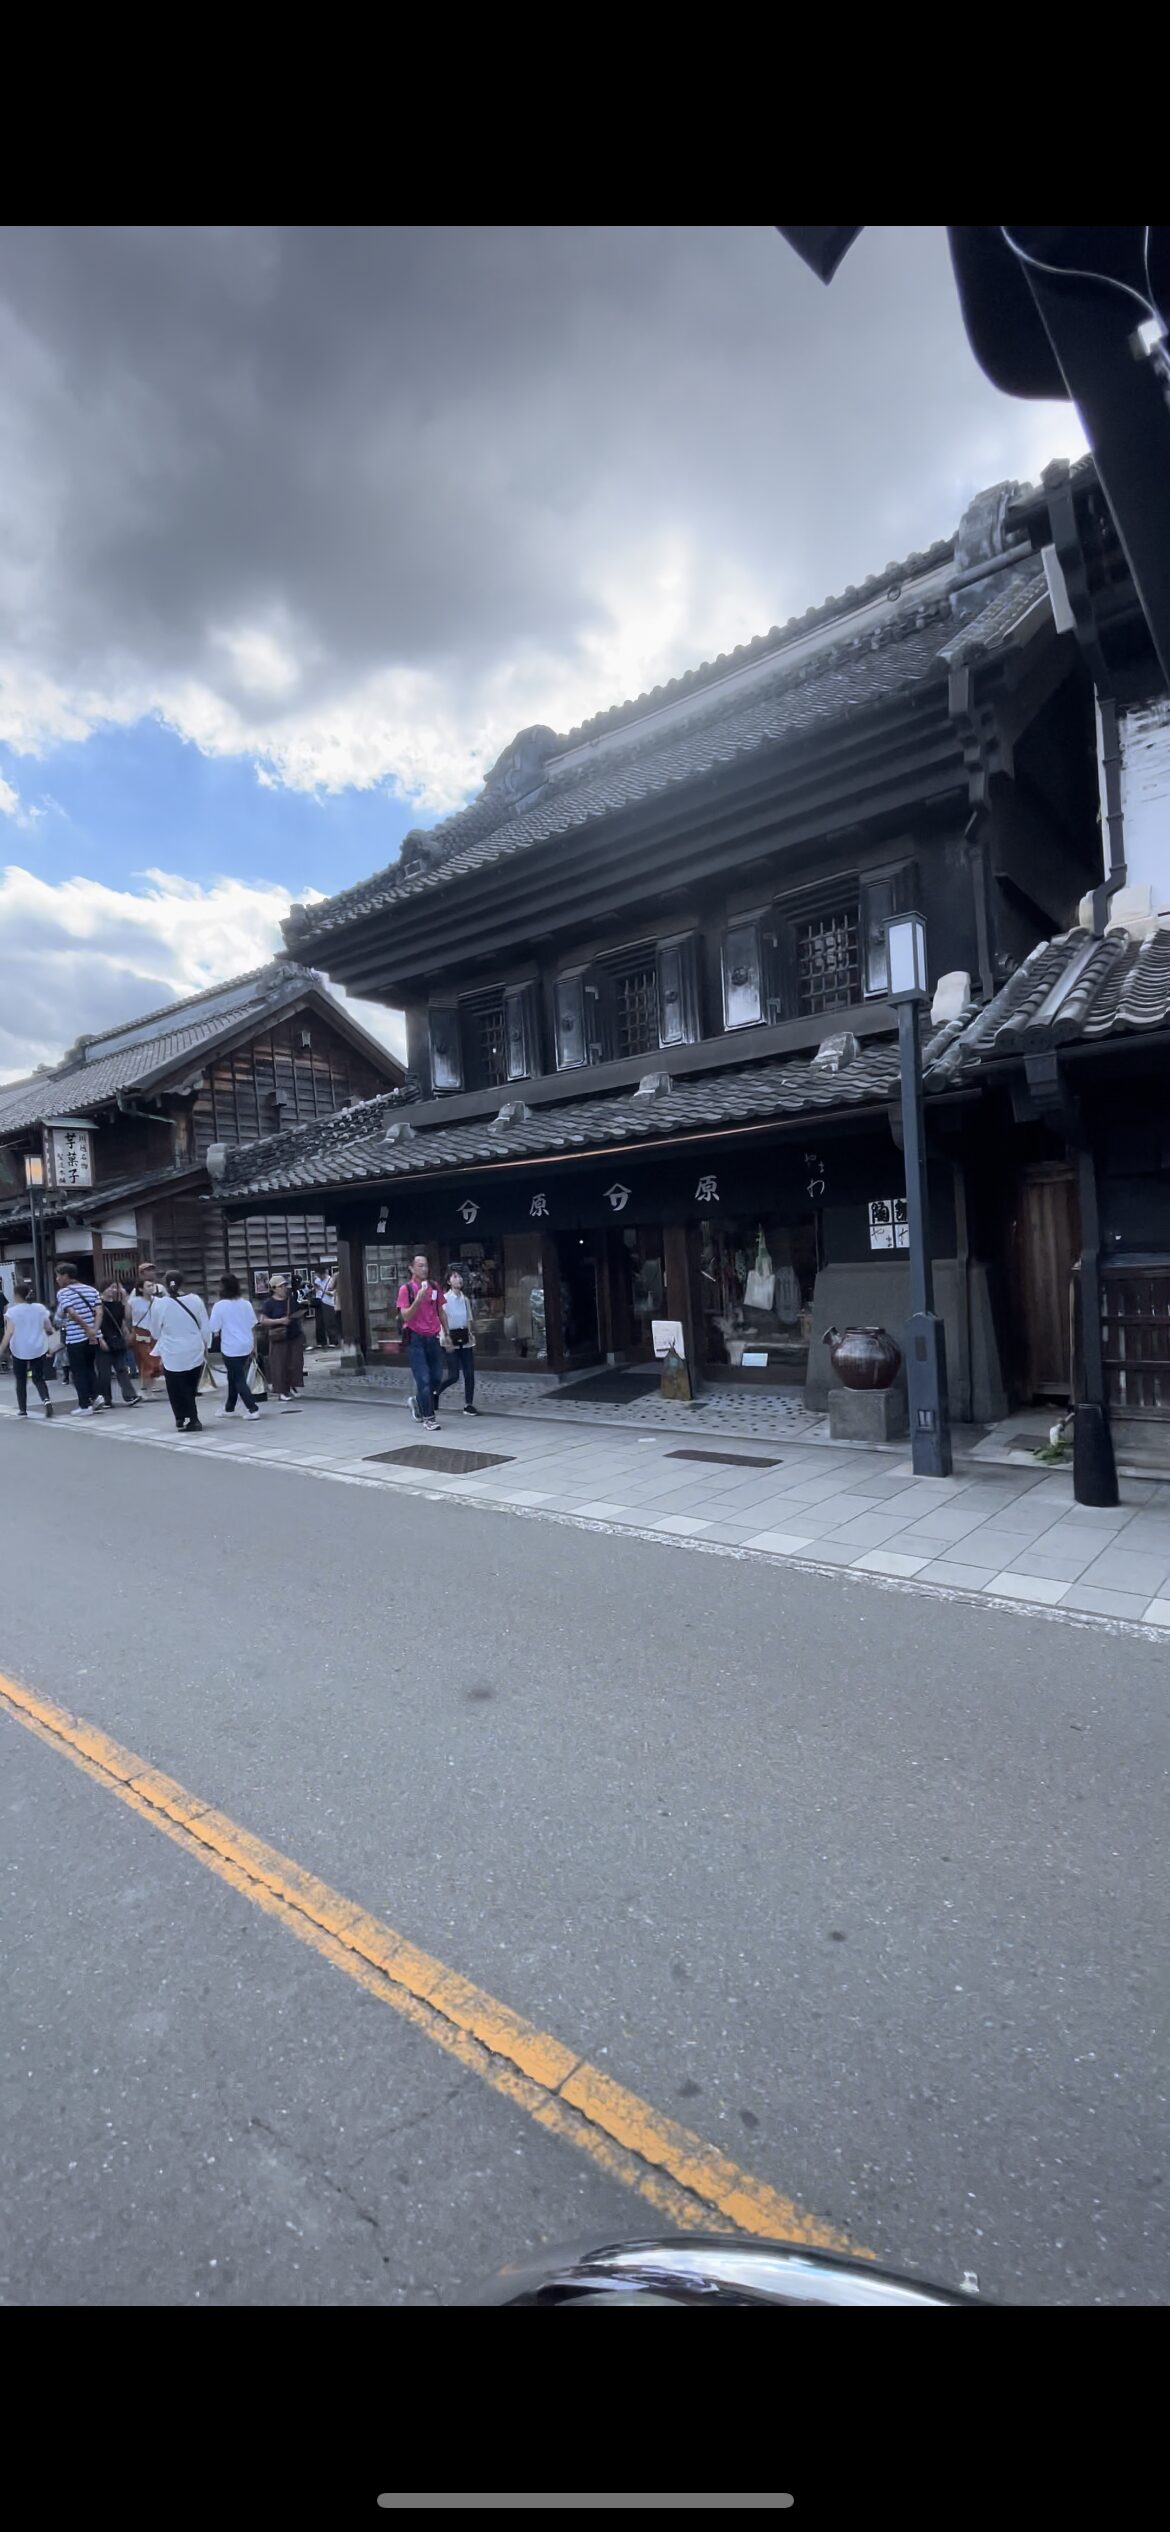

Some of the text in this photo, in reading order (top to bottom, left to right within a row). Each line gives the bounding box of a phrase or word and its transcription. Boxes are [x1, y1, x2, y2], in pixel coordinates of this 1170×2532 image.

[65, 1132, 79, 1184] 芋菓子
[529, 1193, 550, 1217] 原
[694, 1174, 720, 1202] 原
